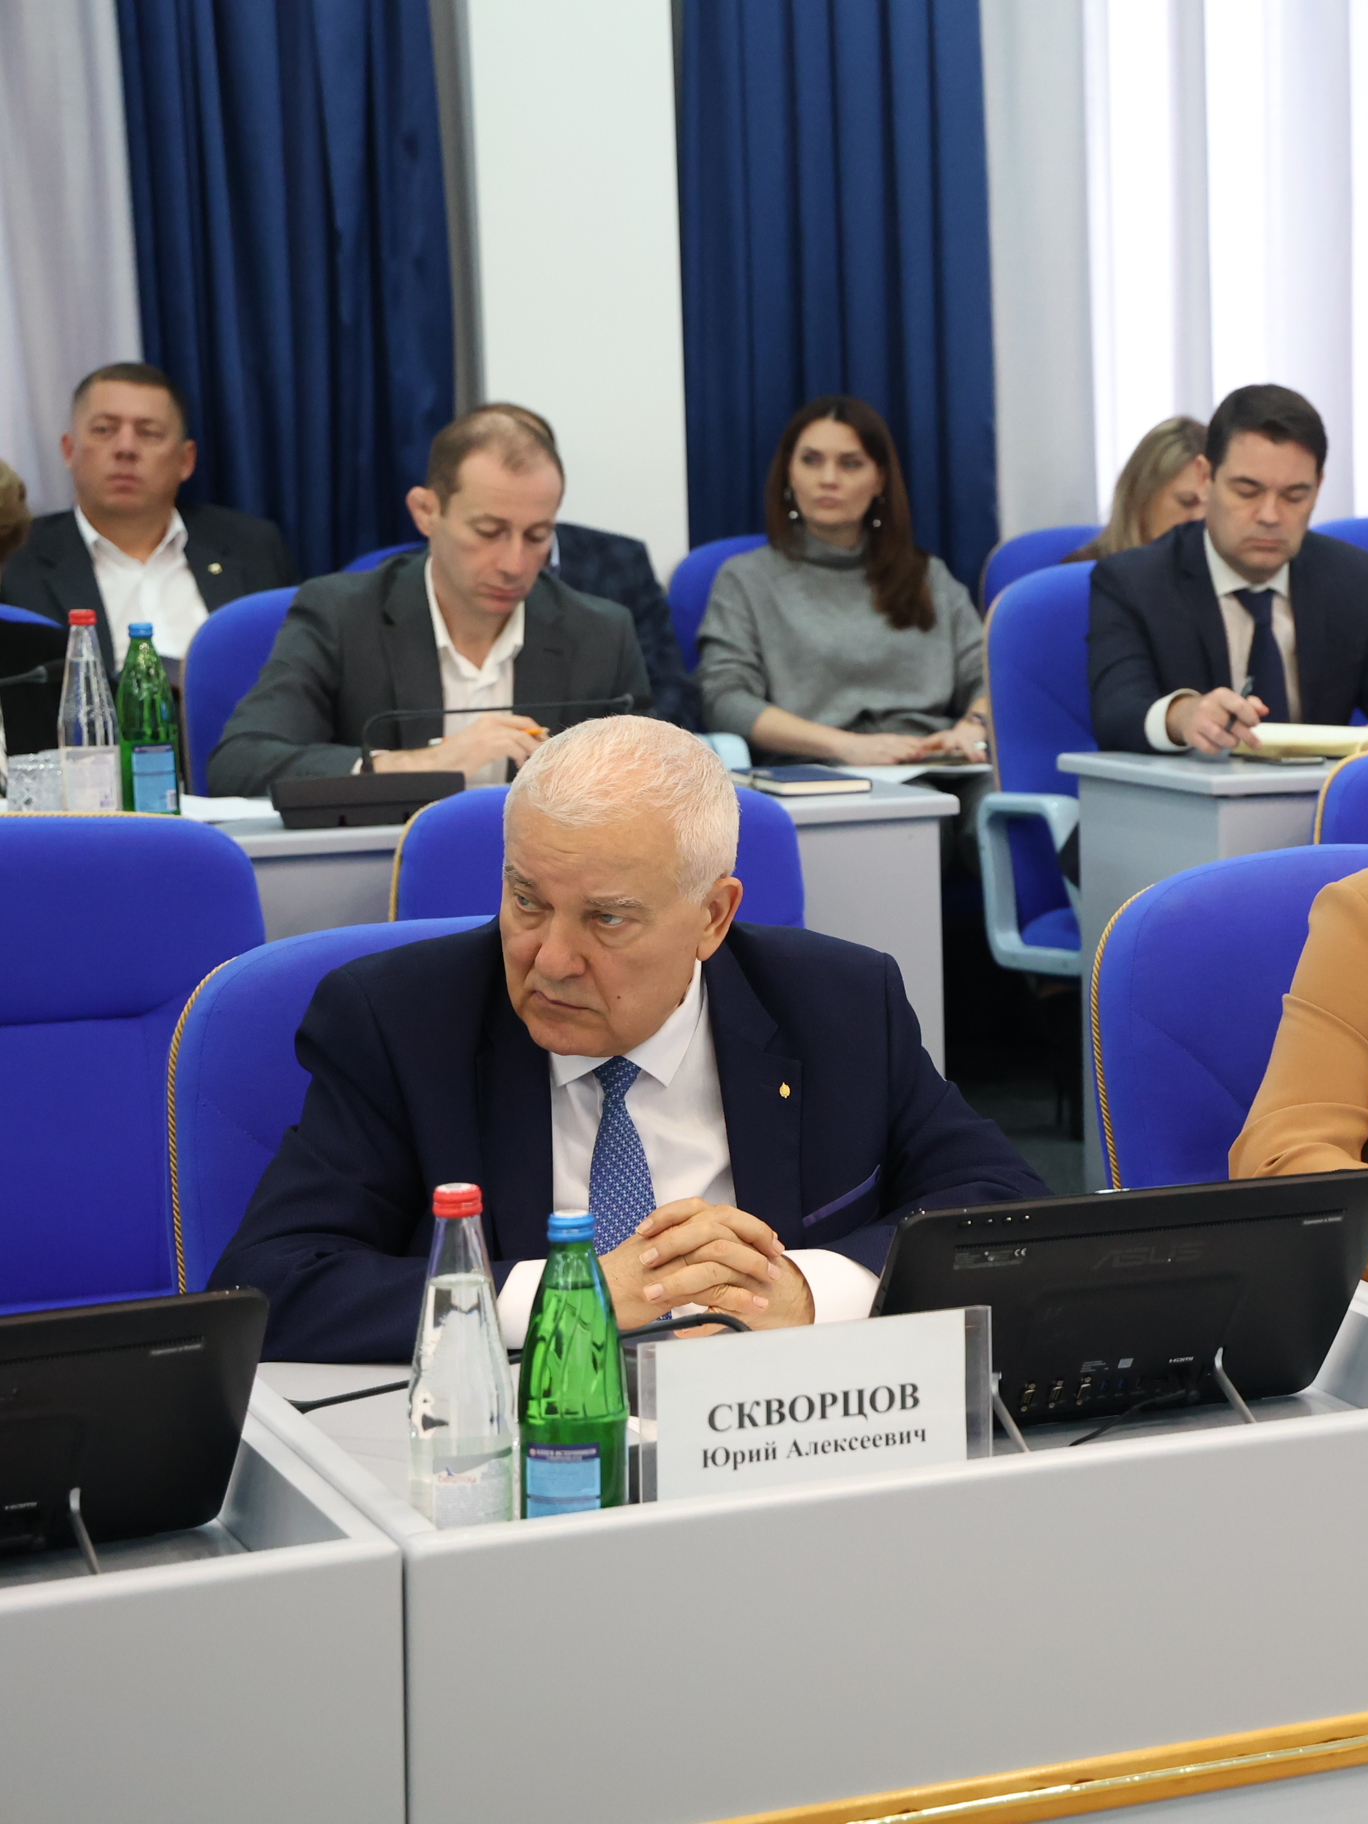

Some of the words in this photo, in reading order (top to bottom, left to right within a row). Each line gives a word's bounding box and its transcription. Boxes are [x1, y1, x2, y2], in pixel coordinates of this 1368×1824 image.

[1091, 1242, 1204, 1271] ASUS
[707, 1382, 921, 1432] СКВОРЦОВ
[702, 1441, 777, 1471] Юрий
[786, 1428, 927, 1459] Алексеевич
